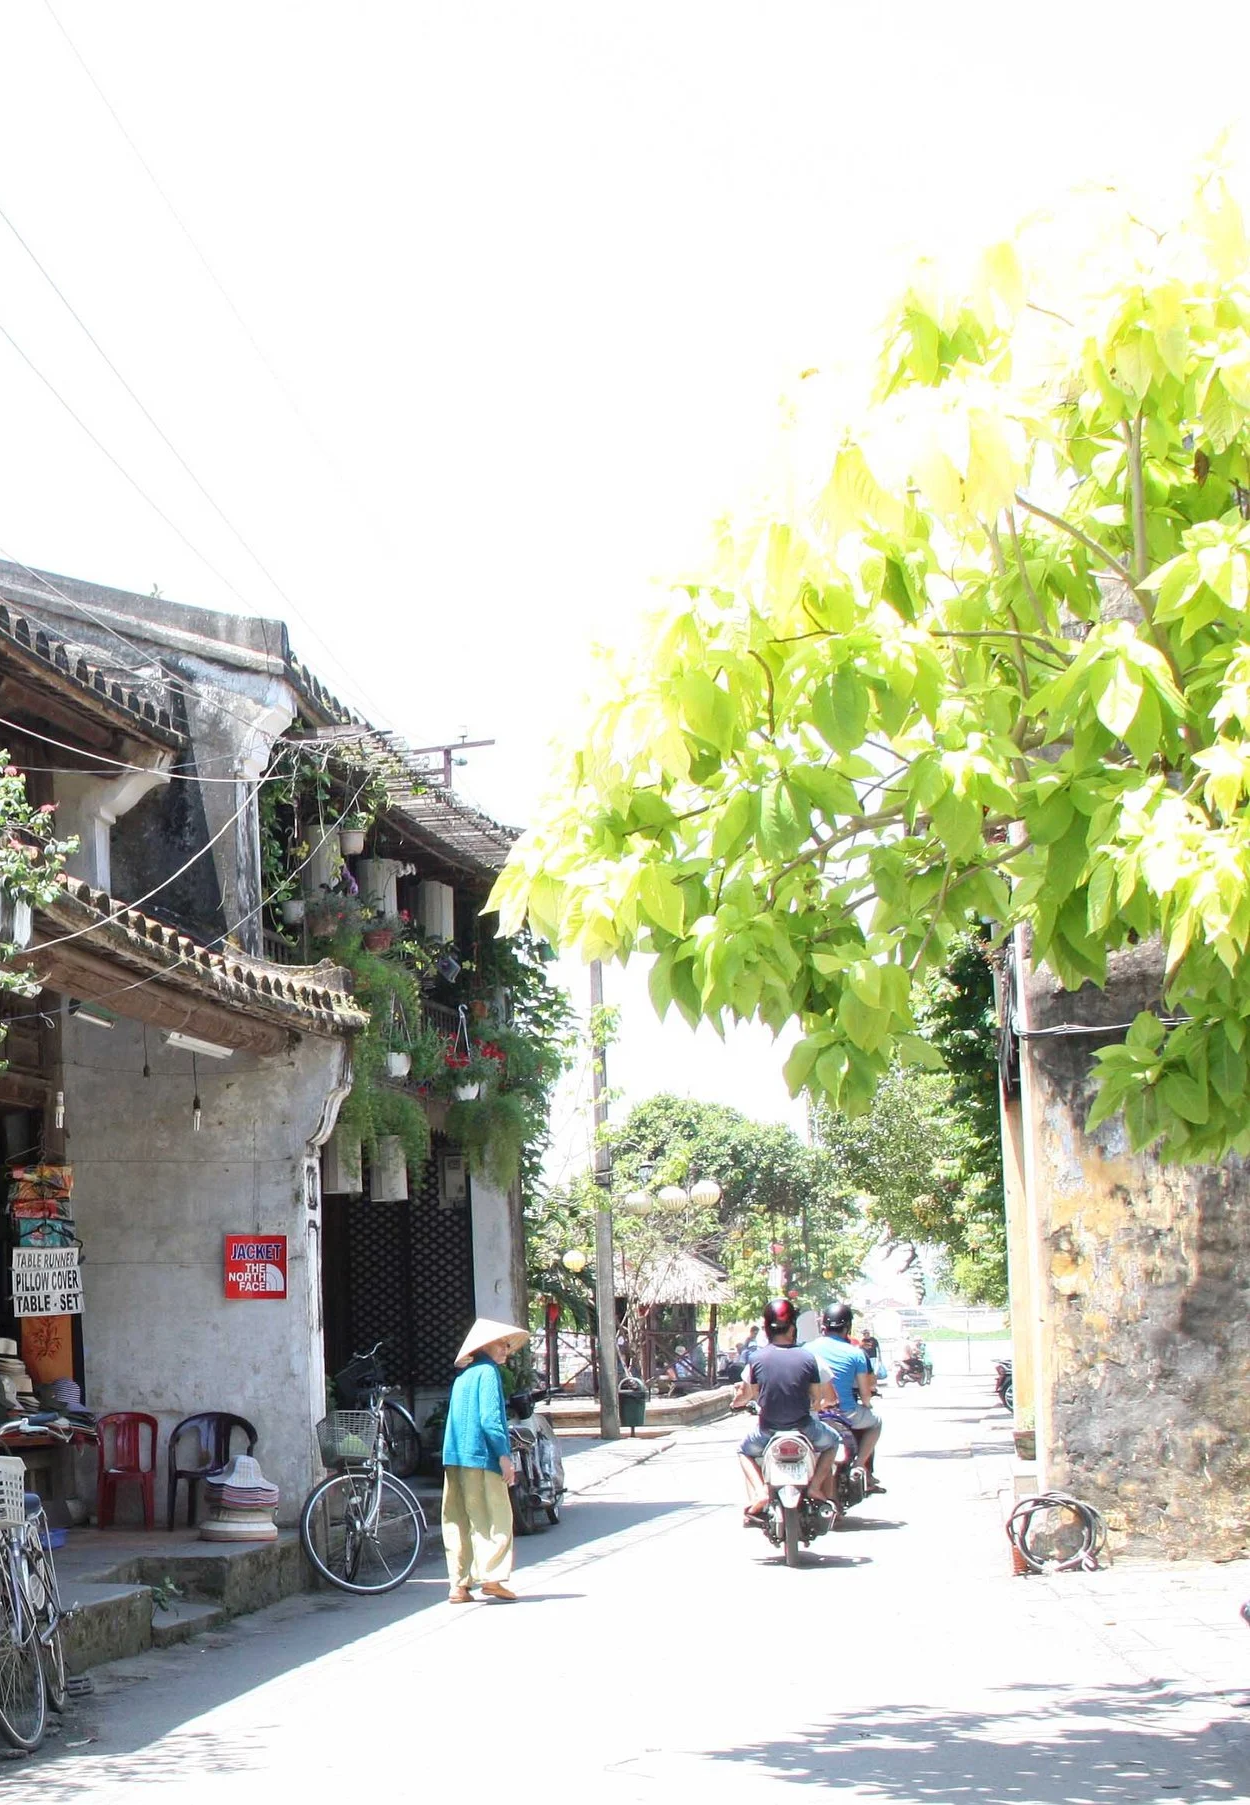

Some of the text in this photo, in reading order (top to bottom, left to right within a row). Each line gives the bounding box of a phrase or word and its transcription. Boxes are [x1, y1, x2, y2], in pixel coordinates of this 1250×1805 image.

[16, 1252, 75, 1268] TABLE RUNNER
[230, 1243, 282, 1261] JACKET
[245, 1263, 266, 1273] THE
[16, 1270, 79, 1292] PILLOW COVER
[228, 1272, 266, 1282] NORTH
[239, 1282, 266, 1292] FACE
[16, 1295, 51, 1313] TABLE
[60, 1293, 80, 1311] SET
